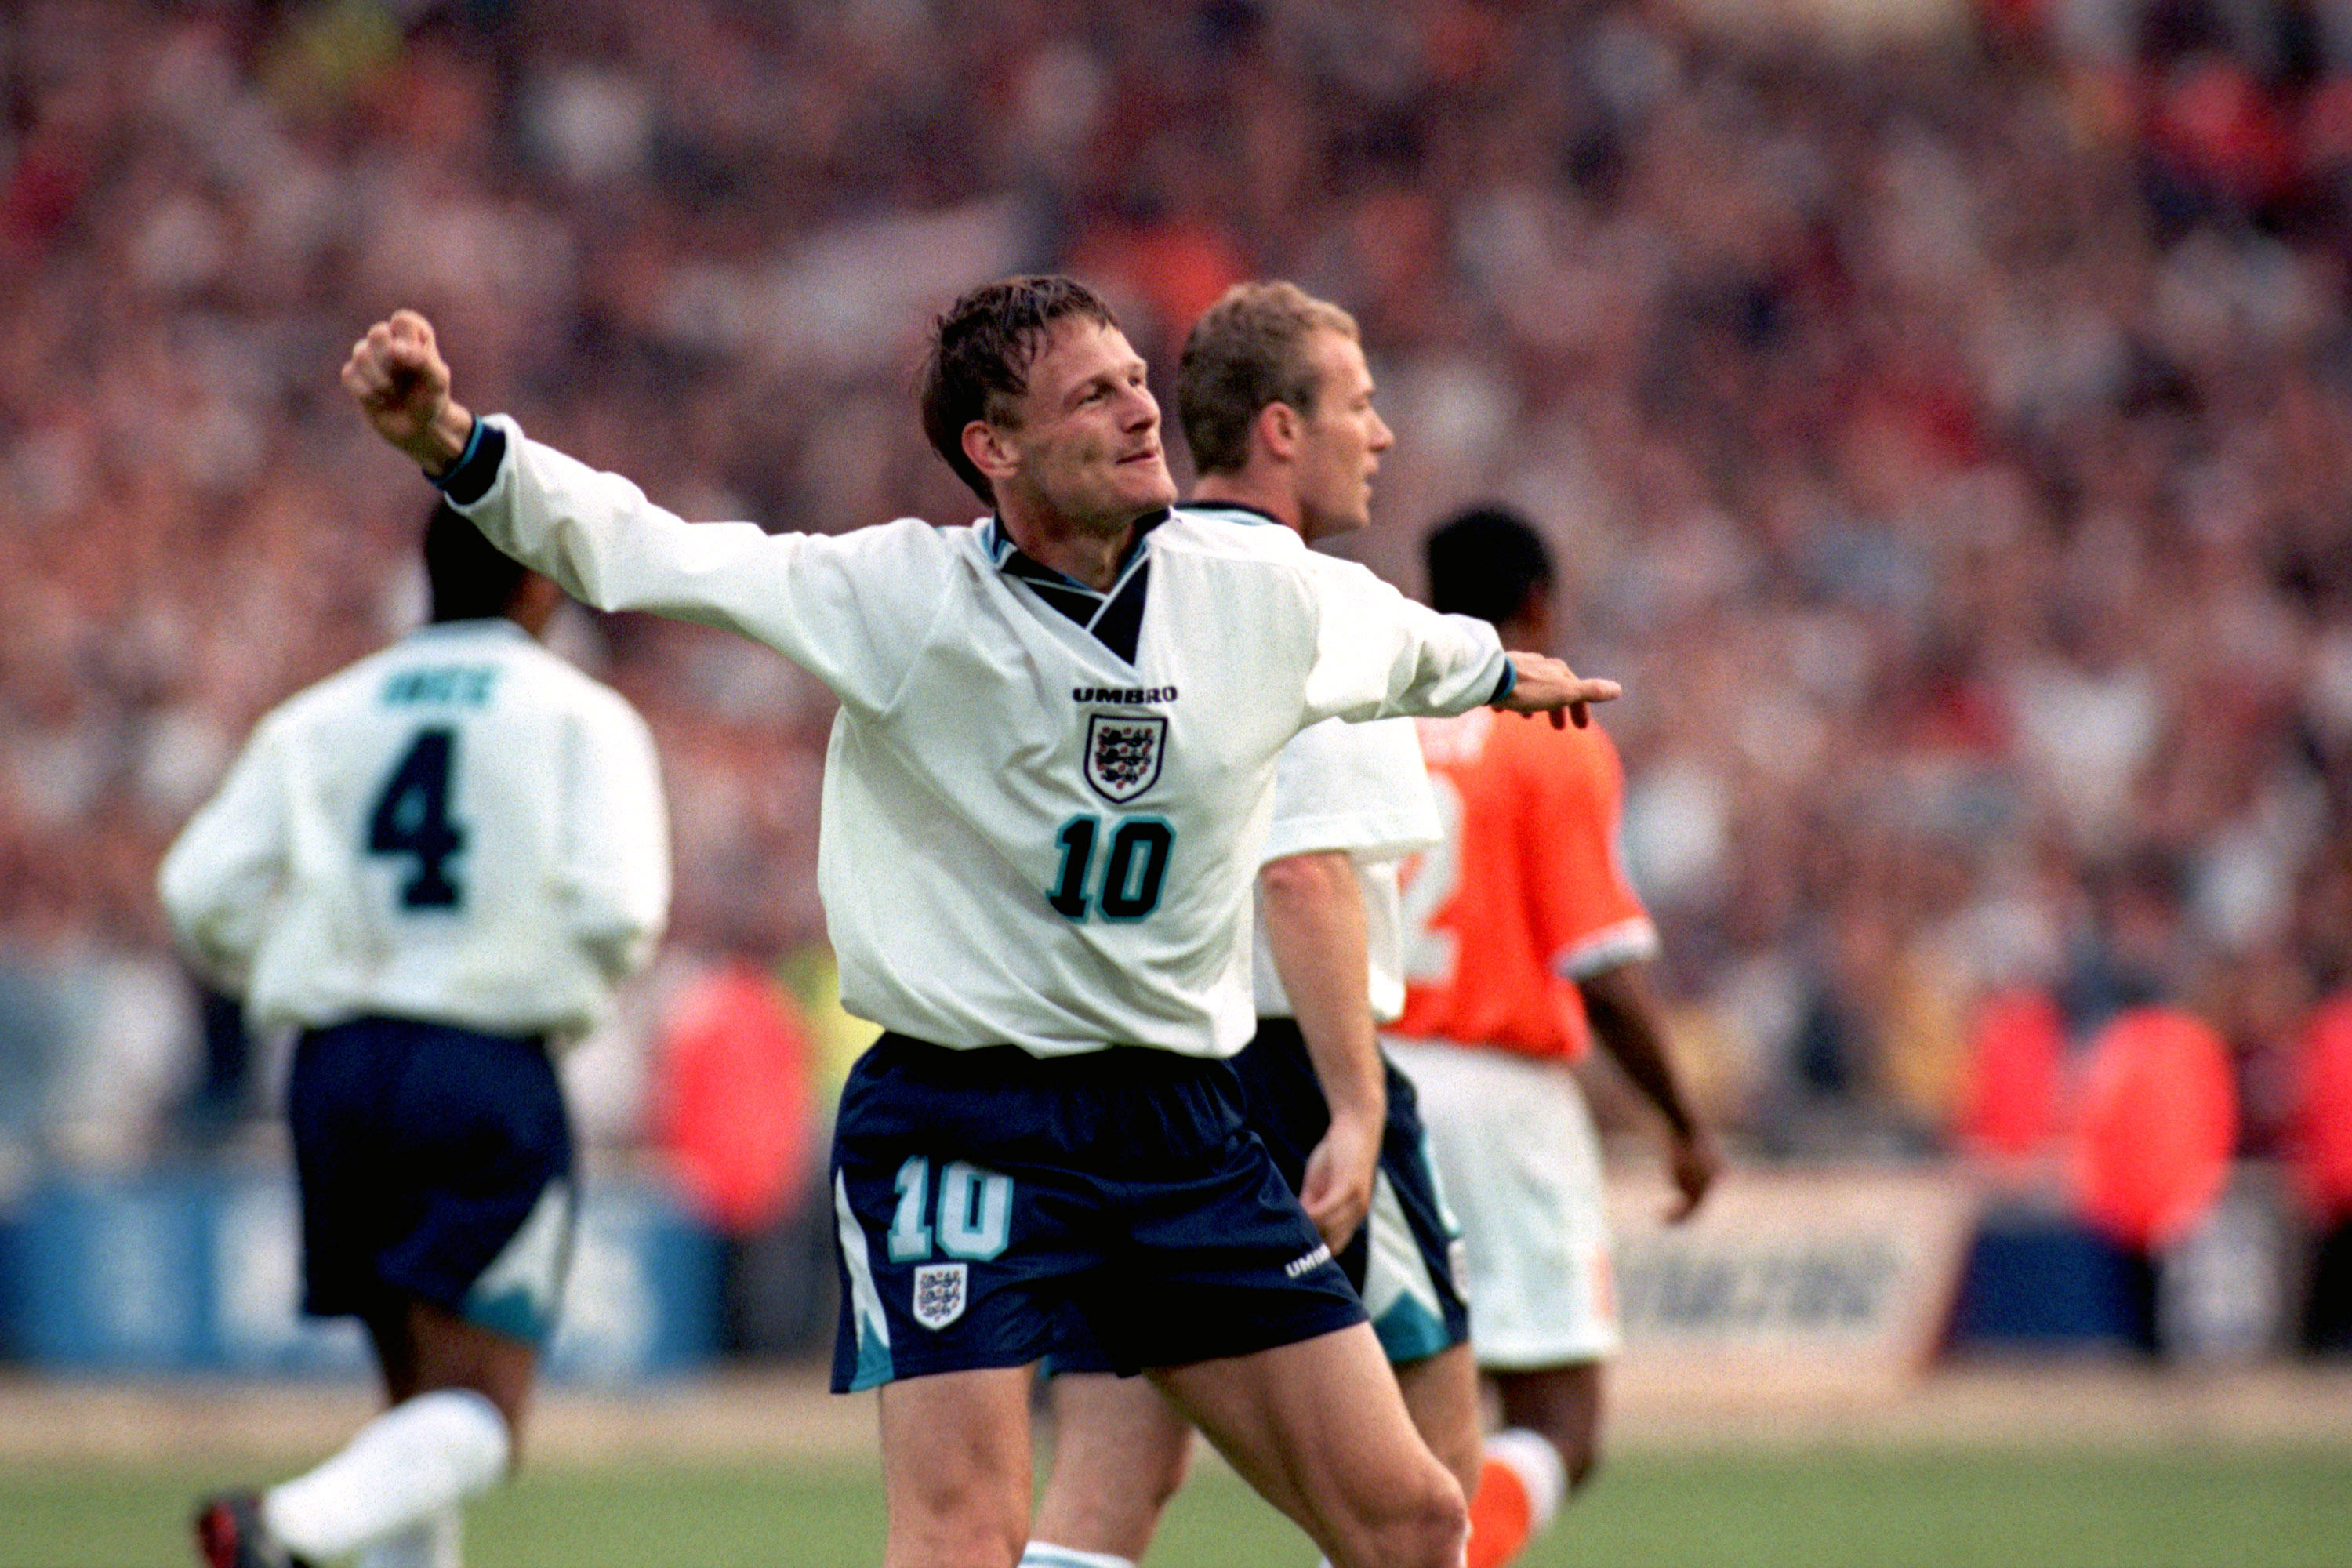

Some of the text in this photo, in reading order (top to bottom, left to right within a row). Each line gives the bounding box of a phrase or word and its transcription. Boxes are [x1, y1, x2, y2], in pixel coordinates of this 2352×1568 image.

[1073, 686, 1178, 704] UMBRO
[365, 724, 469, 913] 4
[1045, 814, 1176, 924] 10
[887, 1154, 1014, 1264] 10
[1284, 1243, 1331, 1279] UMB
